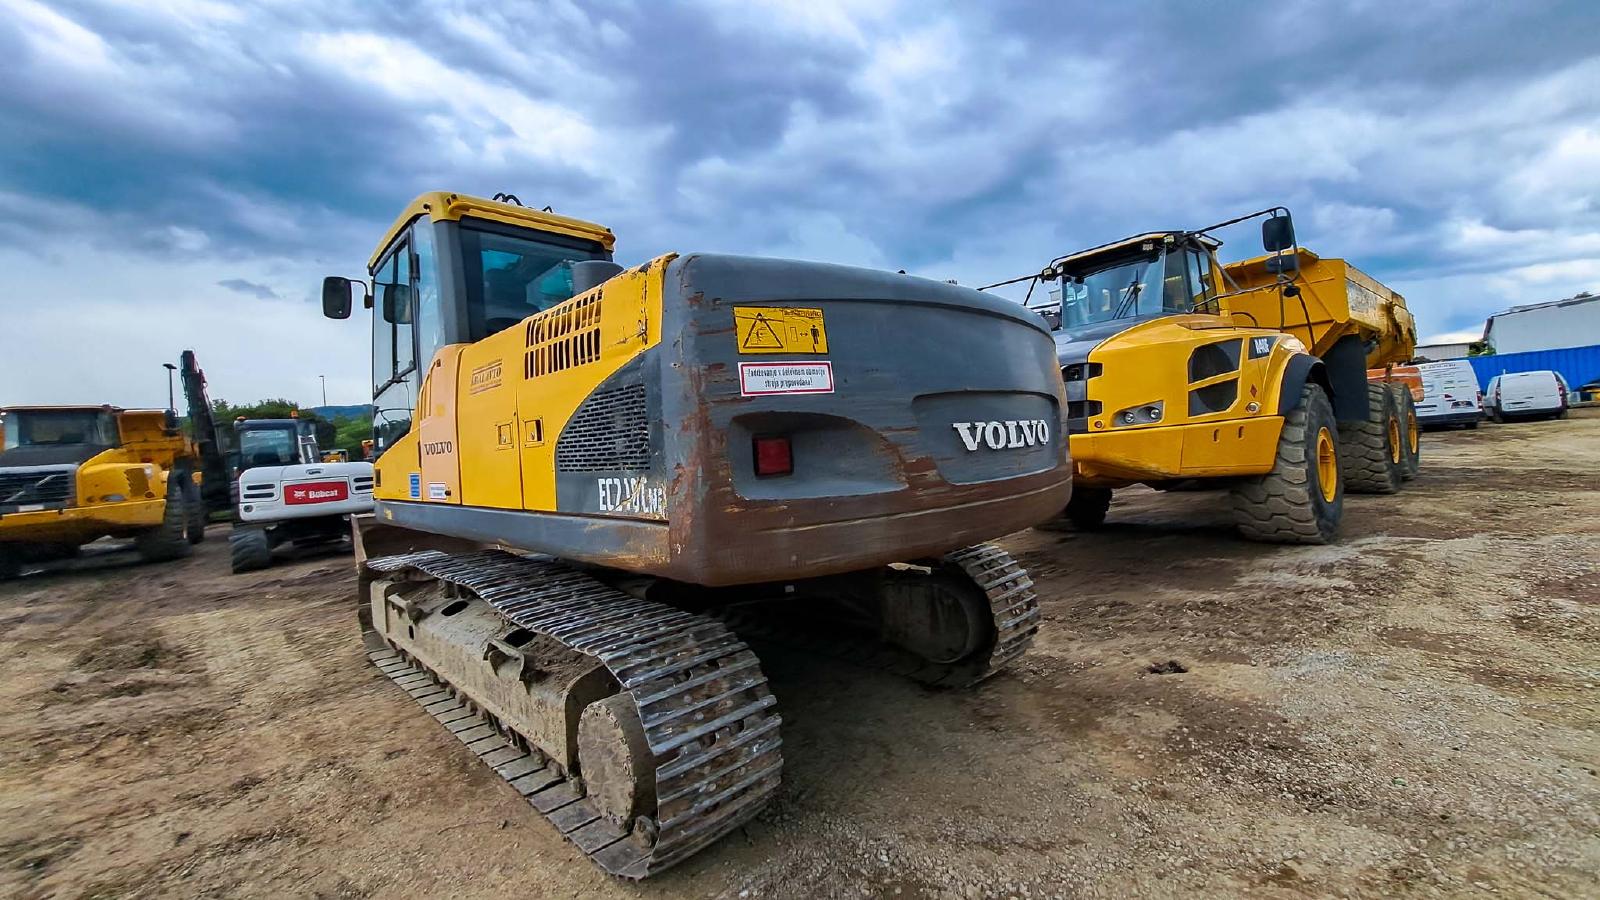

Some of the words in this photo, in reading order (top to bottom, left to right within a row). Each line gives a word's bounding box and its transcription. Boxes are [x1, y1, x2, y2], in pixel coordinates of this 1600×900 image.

[953, 420, 1049, 451] VOLVO
[425, 441, 452, 455] VOLVO
[309, 490, 337, 499] Bobcat
